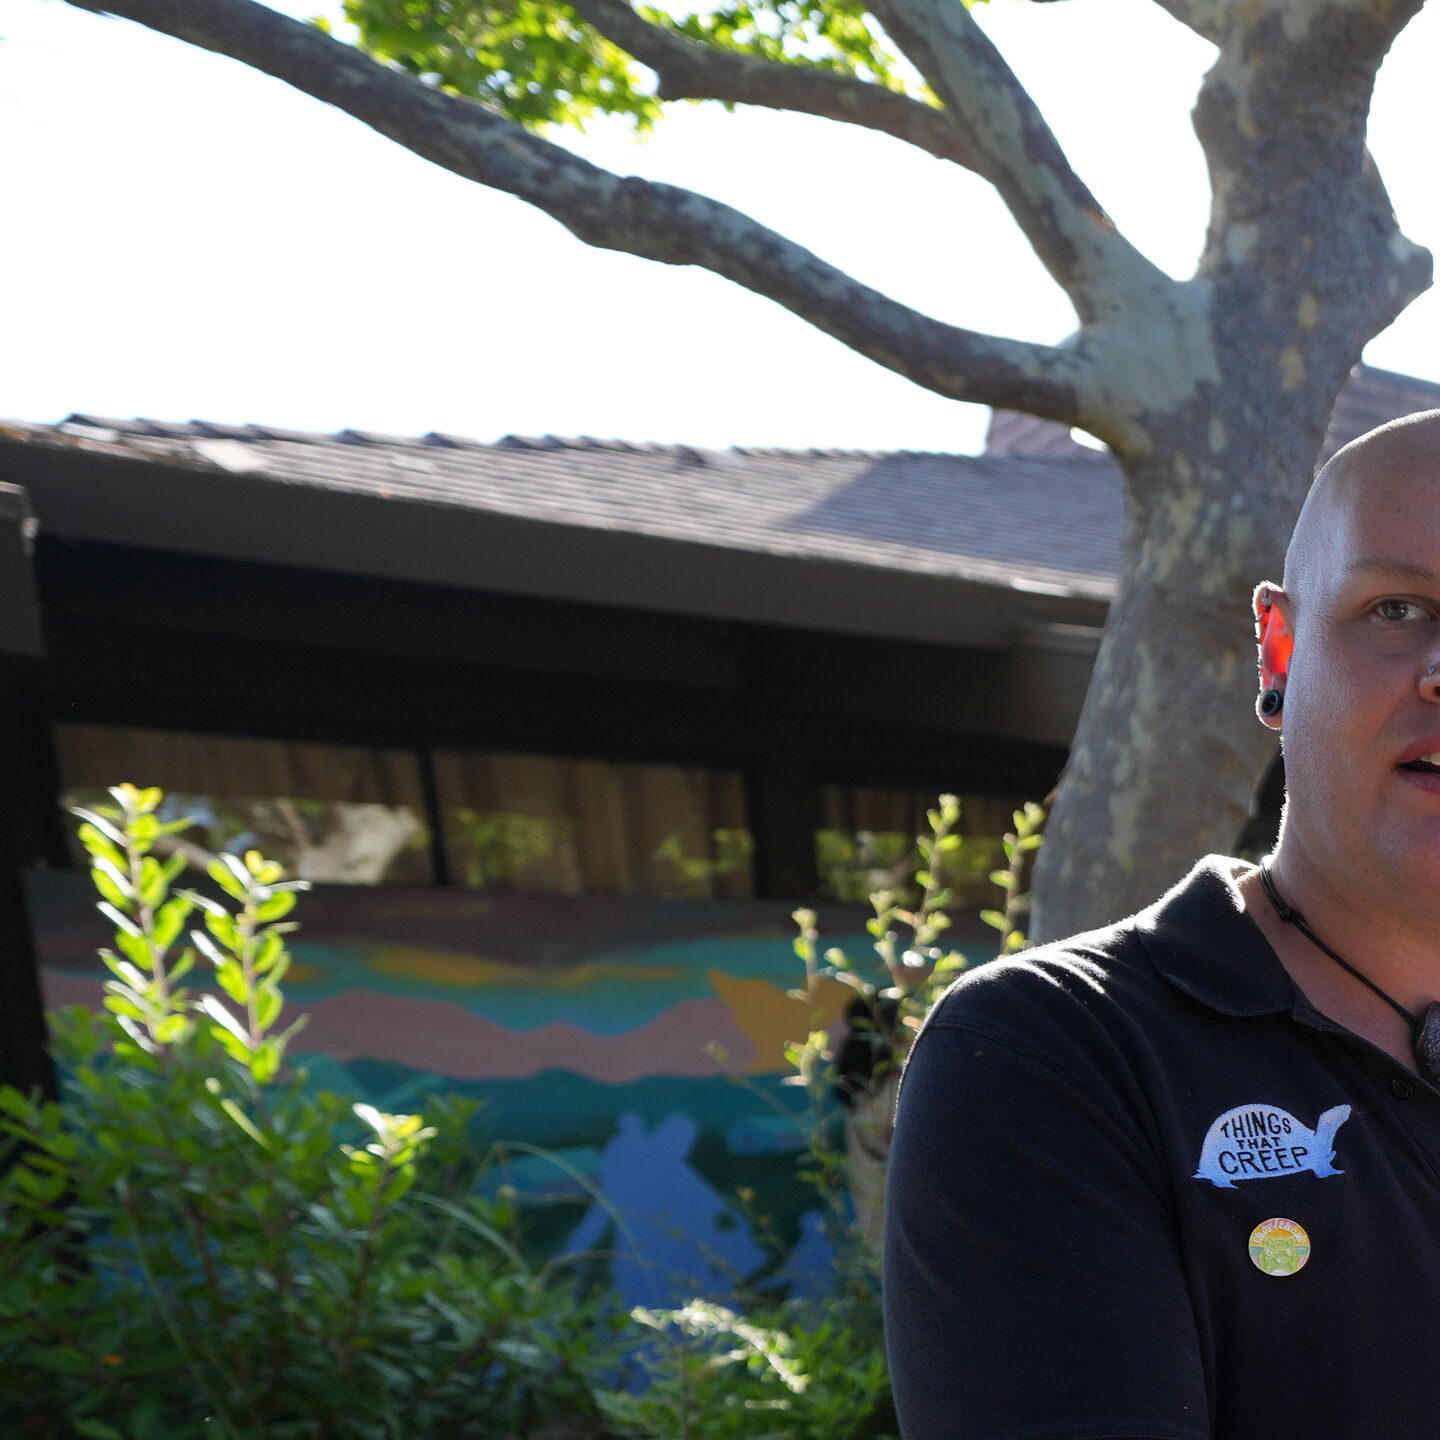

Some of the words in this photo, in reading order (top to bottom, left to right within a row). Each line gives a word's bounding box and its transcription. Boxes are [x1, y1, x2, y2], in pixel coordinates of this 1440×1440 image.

[1220, 1111, 1292, 1140] THINGS
[1236, 1136, 1281, 1150] THAT
[1218, 1146, 1308, 1175] CREEP
